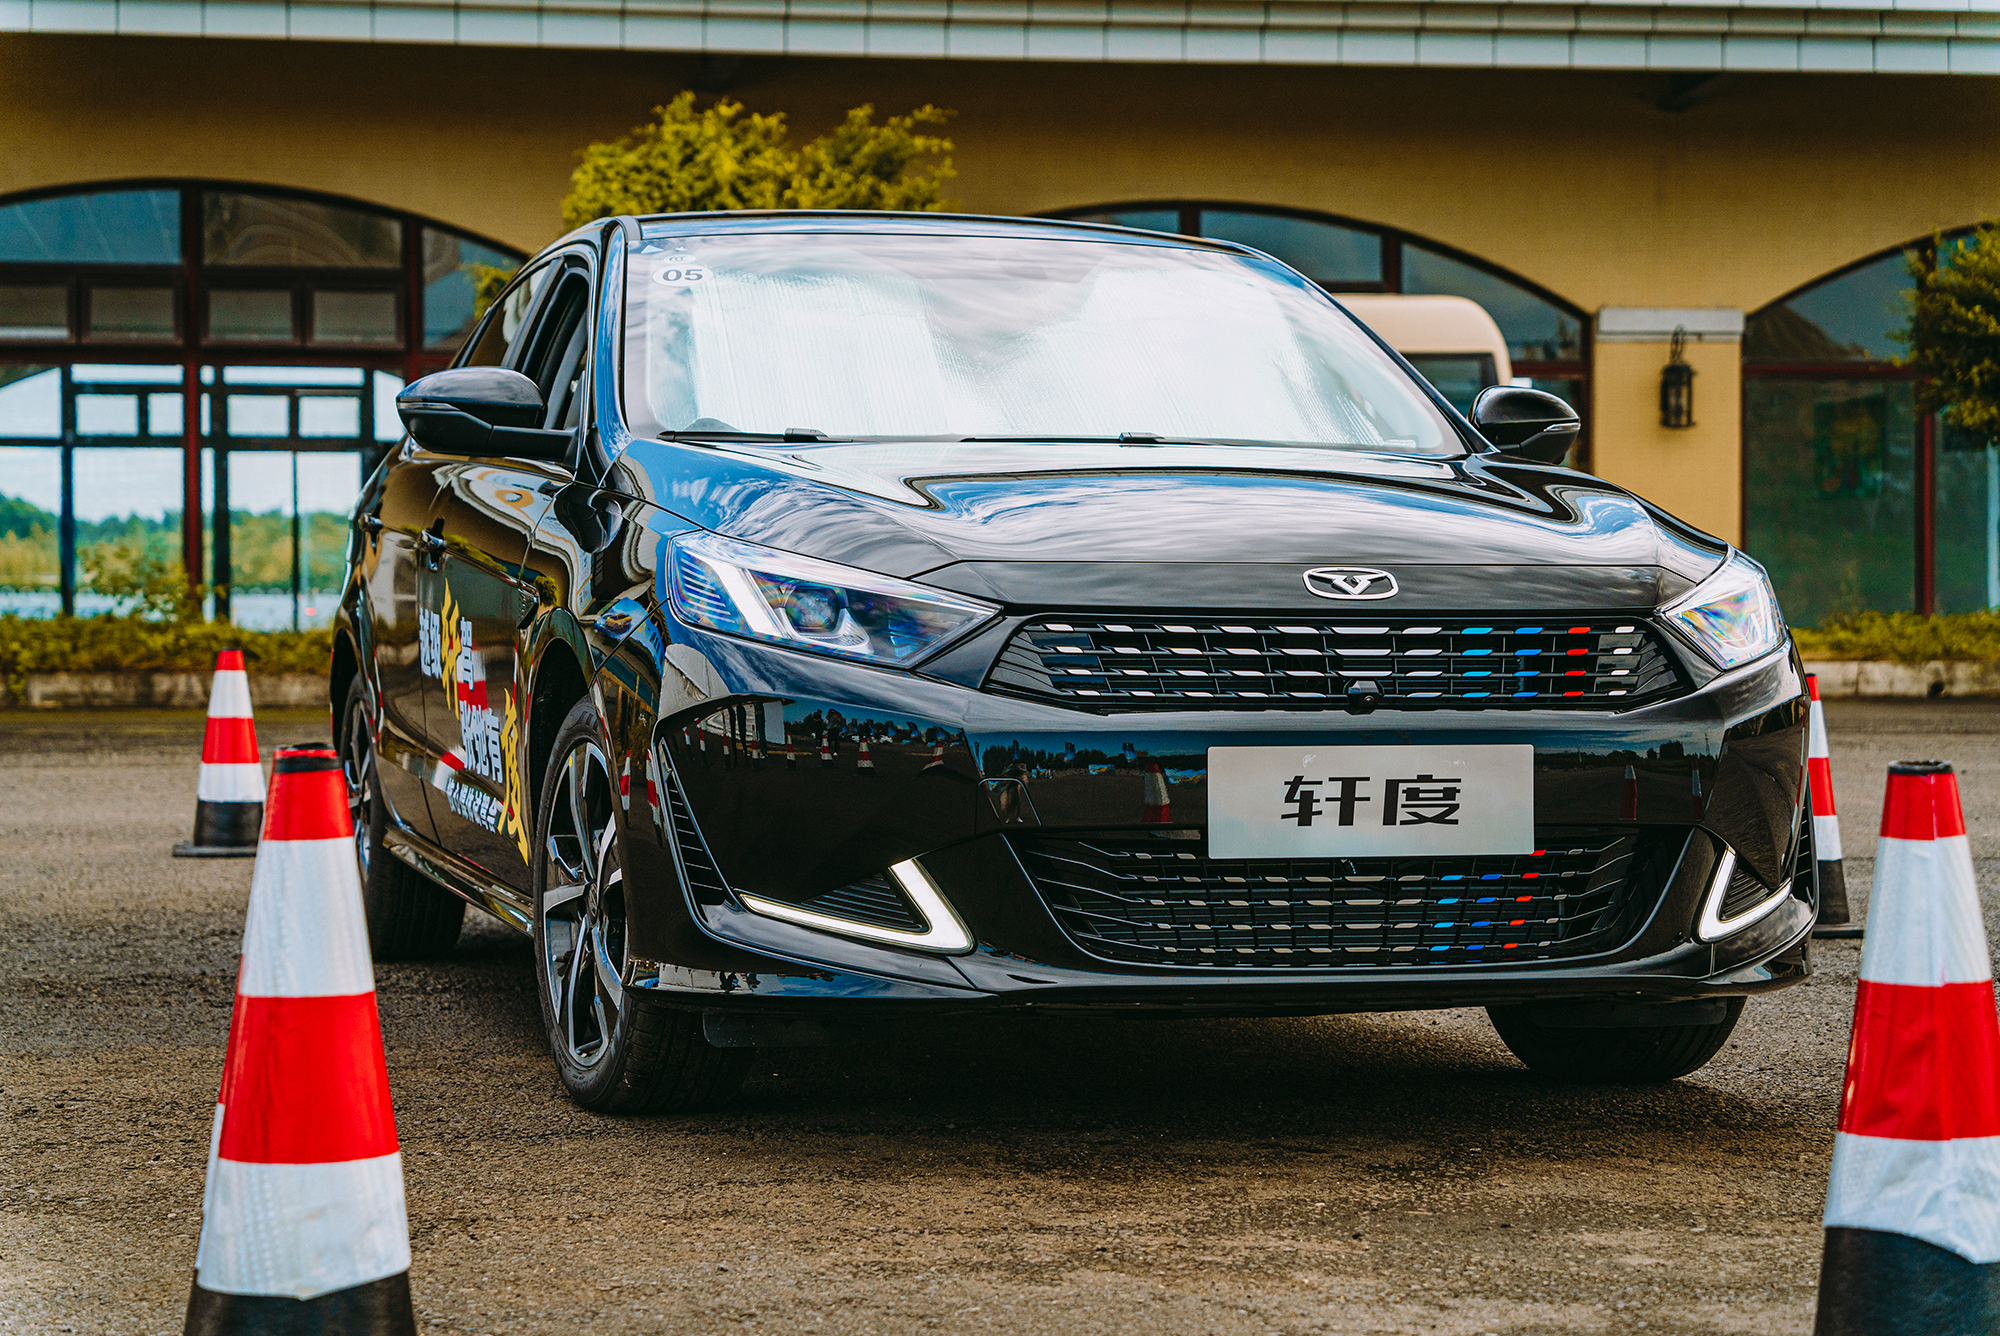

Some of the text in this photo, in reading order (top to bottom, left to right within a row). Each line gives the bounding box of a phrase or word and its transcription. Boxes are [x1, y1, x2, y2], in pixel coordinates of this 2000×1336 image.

[662, 269, 703, 281] 05
[419, 579, 474, 720] 越级轩驾
[459, 688, 528, 866] 张弛有度
[1281, 774, 1462, 826] 轩度
